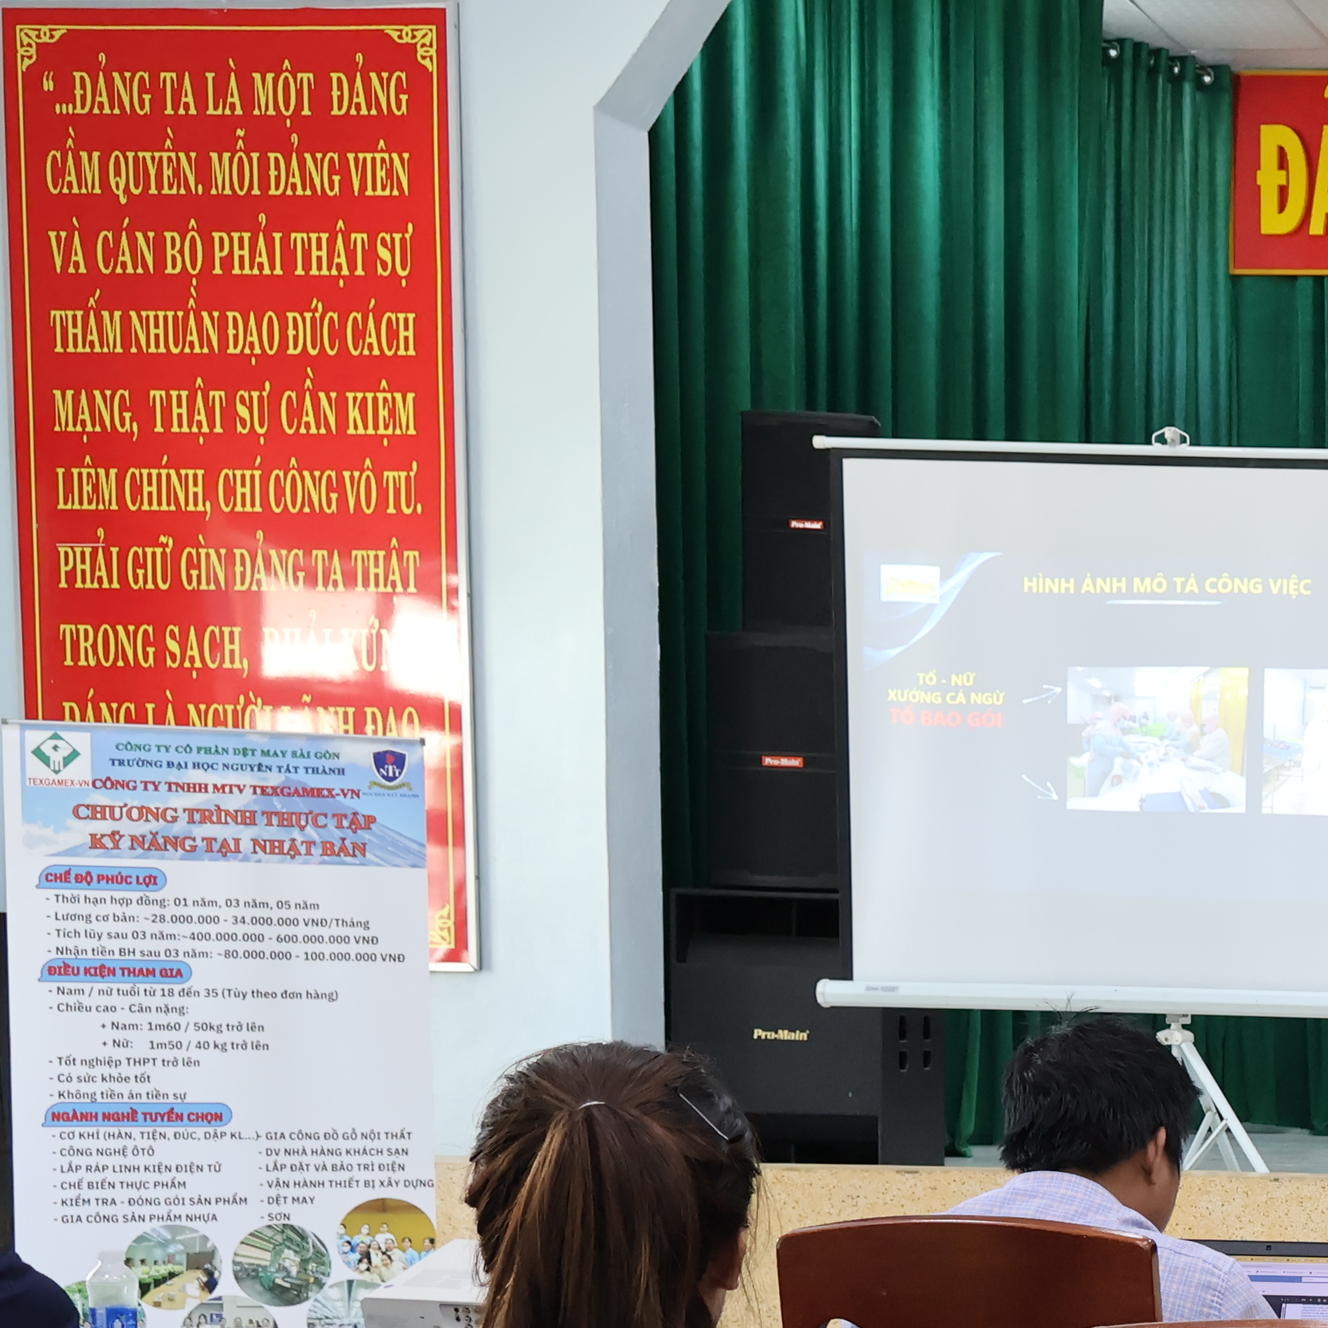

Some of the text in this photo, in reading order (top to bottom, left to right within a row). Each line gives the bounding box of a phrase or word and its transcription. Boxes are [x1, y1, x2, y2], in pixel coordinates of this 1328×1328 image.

[160, 72, 197, 114] TA
[205, 58, 243, 115] LÀ
[252, 59, 314, 127] MỘT
[330, 53, 408, 115] ĐẢNG
[46, 127, 410, 204] CẦM QUYỀN. MỖI ĐẢNG VIÊN
[1023, 572, 1312, 599] HÌNH ẢNH MÔ TẢ CÔNG VIỆC
[920, 710, 964, 727] BAO
[28, 777, 90, 788] TEXGAMEX-VN
[91, 777, 137, 790] CÔNG
[141, 781, 159, 791] TY
[166, 782, 209, 793] TNHH
[213, 783, 244, 794] MTV
[250, 785, 360, 798] TEXGAMEX-VN
[73, 804, 376, 832] CHƯƠNG TRÌNH THỰC TẬP
[90, 831, 366, 858] KỸ NĂNG TẠI NHẬT BẢN
[45, 869, 158, 886] CHẾ ĐỘ PHÚC LỢI
[57, 1054, 200, 1068] Tốt nghiệp THPT trở lên
[58, 1072, 150, 1083] Có sức khỏe tốt
[268, 1194, 288, 1206] DỆT
[268, 1212, 290, 1221] SƠN
